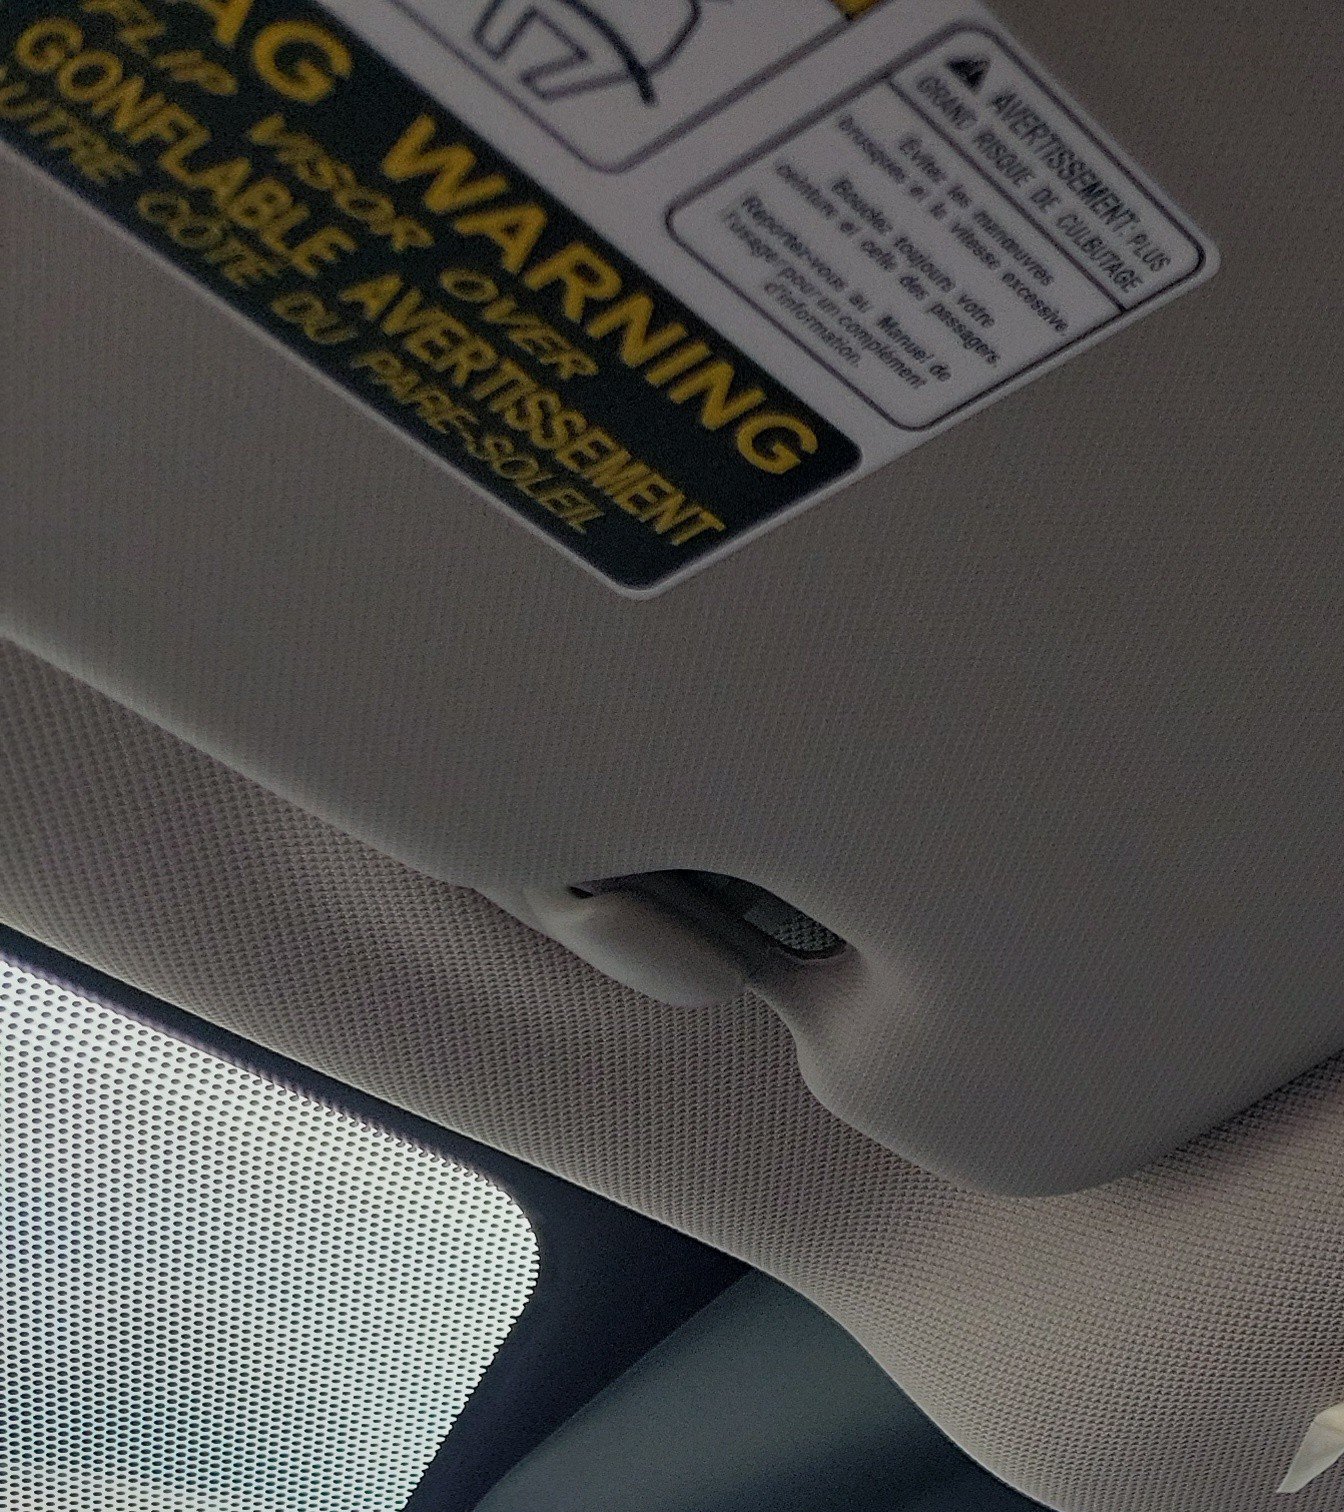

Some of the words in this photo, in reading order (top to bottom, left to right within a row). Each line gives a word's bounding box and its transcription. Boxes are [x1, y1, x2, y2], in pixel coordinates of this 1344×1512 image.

[250, 114, 432, 252] VISOR
[440, 268, 598, 380] OVER
[973, 129, 1034, 185] RISQUE
[1029, 186, 1060, 211] DE
[1057, 213, 1142, 292] CULBUTAGE
[1127, 232, 1171, 271] PLUS
[15, 18, 358, 278] GONFLABLE
[340, 273, 725, 546] AVERTISSEMENT
[380, 115, 819, 475] WARNING
[764, 283, 864, 367] d'information.
[890, 236, 955, 292] toujours
[957, 293, 994, 327] votre
[899, 275, 928, 299] des
[950, 222, 1000, 268] vitesse
[1001, 271, 1072, 336] excessive.
[838, 316, 926, 388] complément
[849, 293, 868, 312] au
[877, 314, 933, 362] Manuel
[929, 363, 951, 381] de
[273, 291, 358, 346] DU
[351, 350, 605, 532] PARE-SOLEIL
